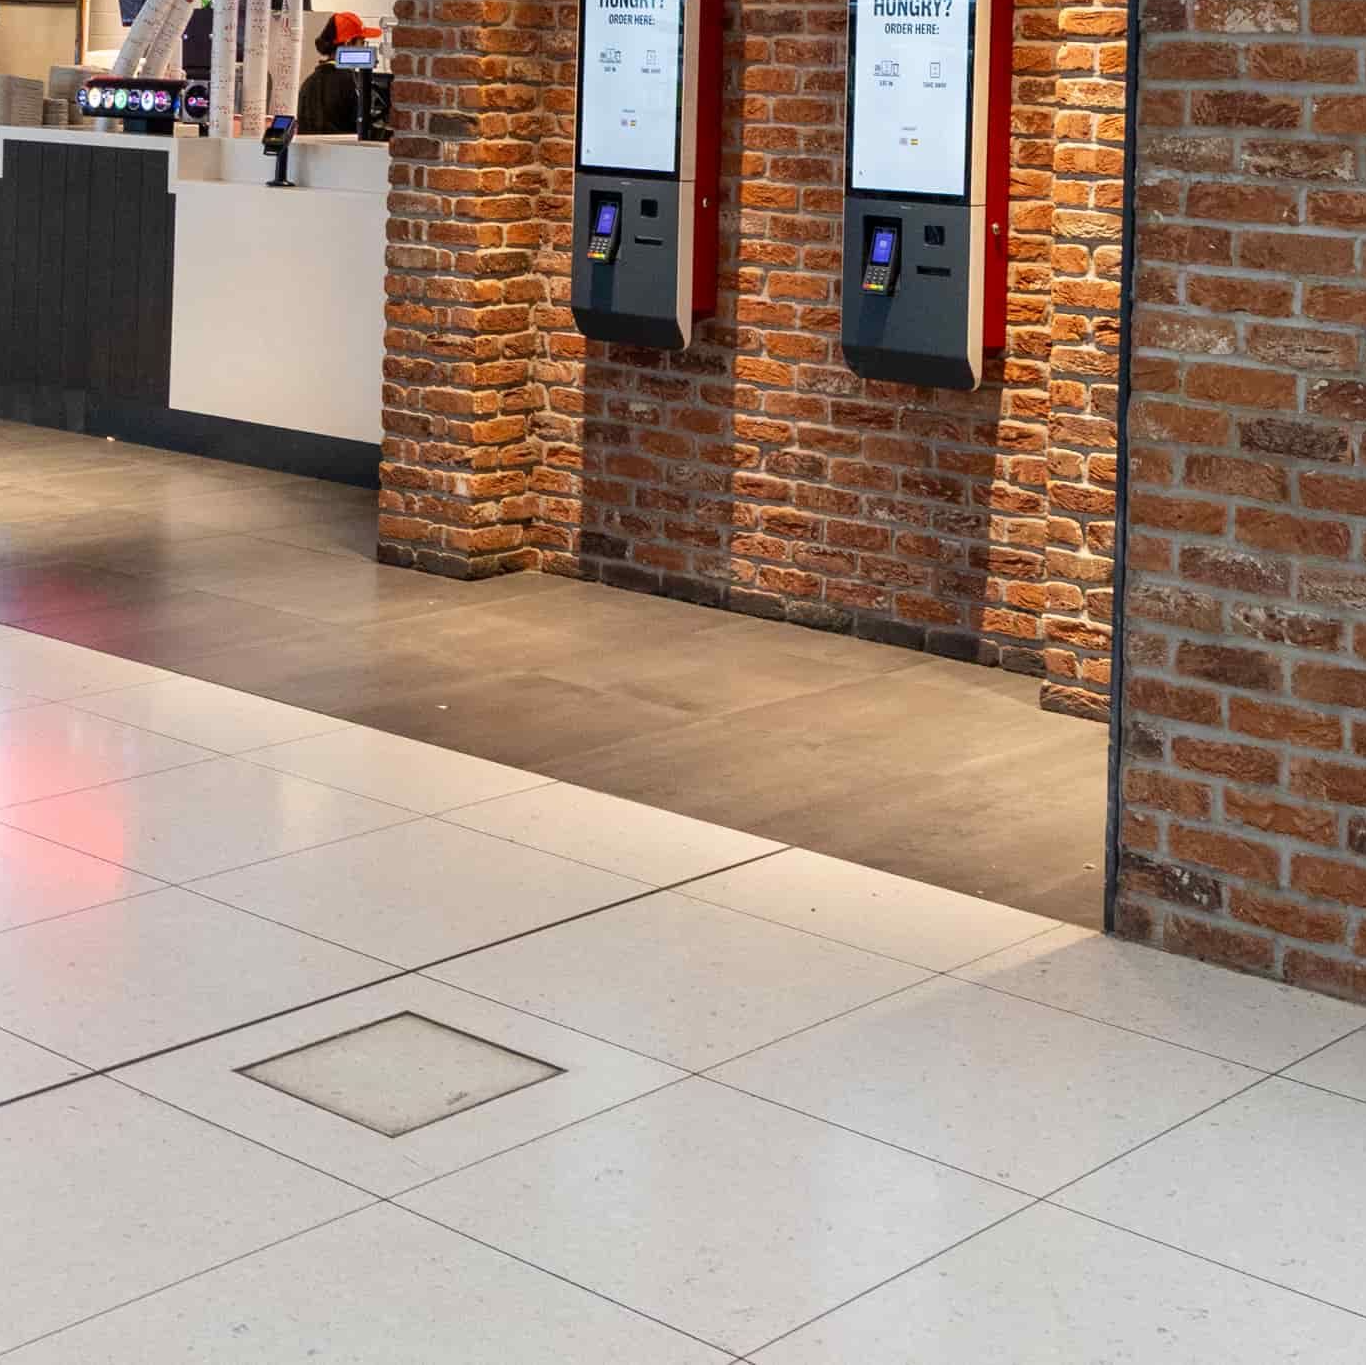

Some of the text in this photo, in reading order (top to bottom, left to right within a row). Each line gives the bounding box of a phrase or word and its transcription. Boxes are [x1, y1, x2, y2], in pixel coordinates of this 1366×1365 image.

[609, 13, 635, 25] ORDER
[884, 23, 940, 35] ORDER HERE:
